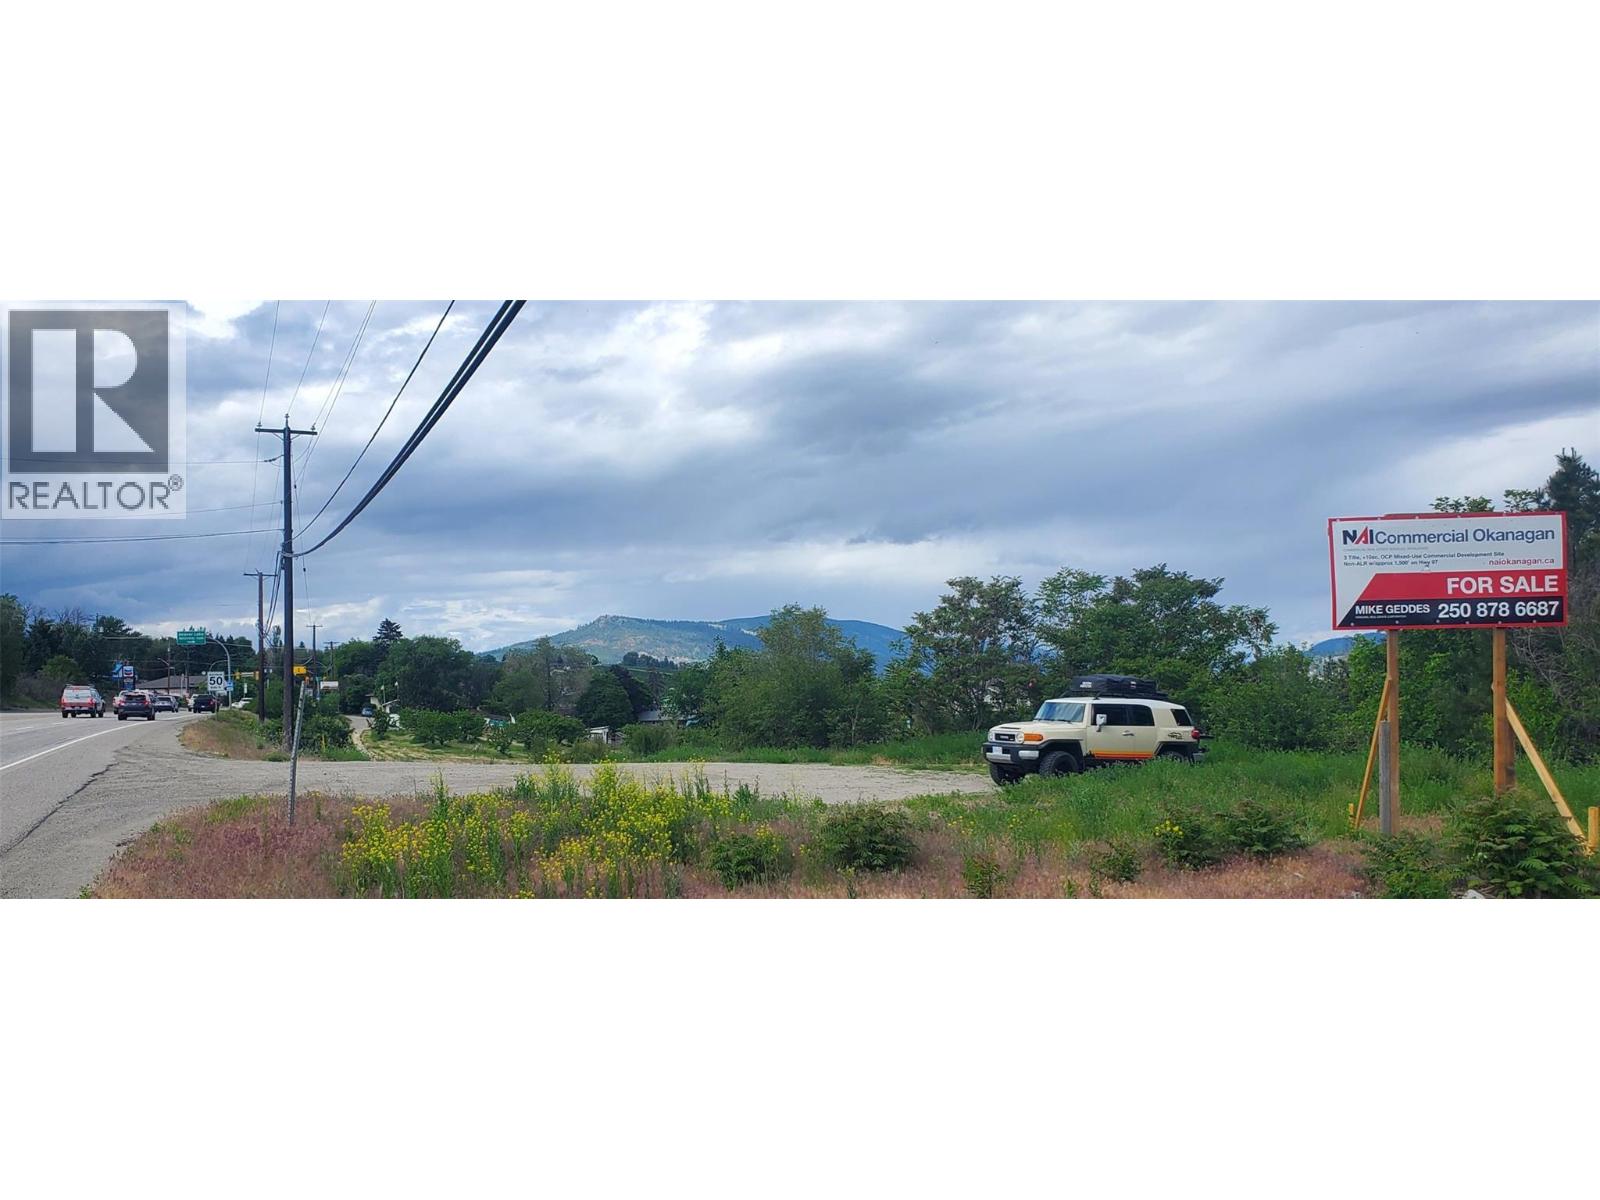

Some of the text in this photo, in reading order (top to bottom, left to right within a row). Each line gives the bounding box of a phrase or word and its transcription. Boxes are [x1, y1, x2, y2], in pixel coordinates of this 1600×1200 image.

[1342, 525, 1555, 545] NAI Commercial Okanagan
[1488, 557, 1555, 566] naiokanagan.ca
[1447, 575, 1559, 594] FOR SALE
[1355, 601, 1559, 618] MIKE GEDDES 250 878 6687
[209, 676, 223, 686] 50
